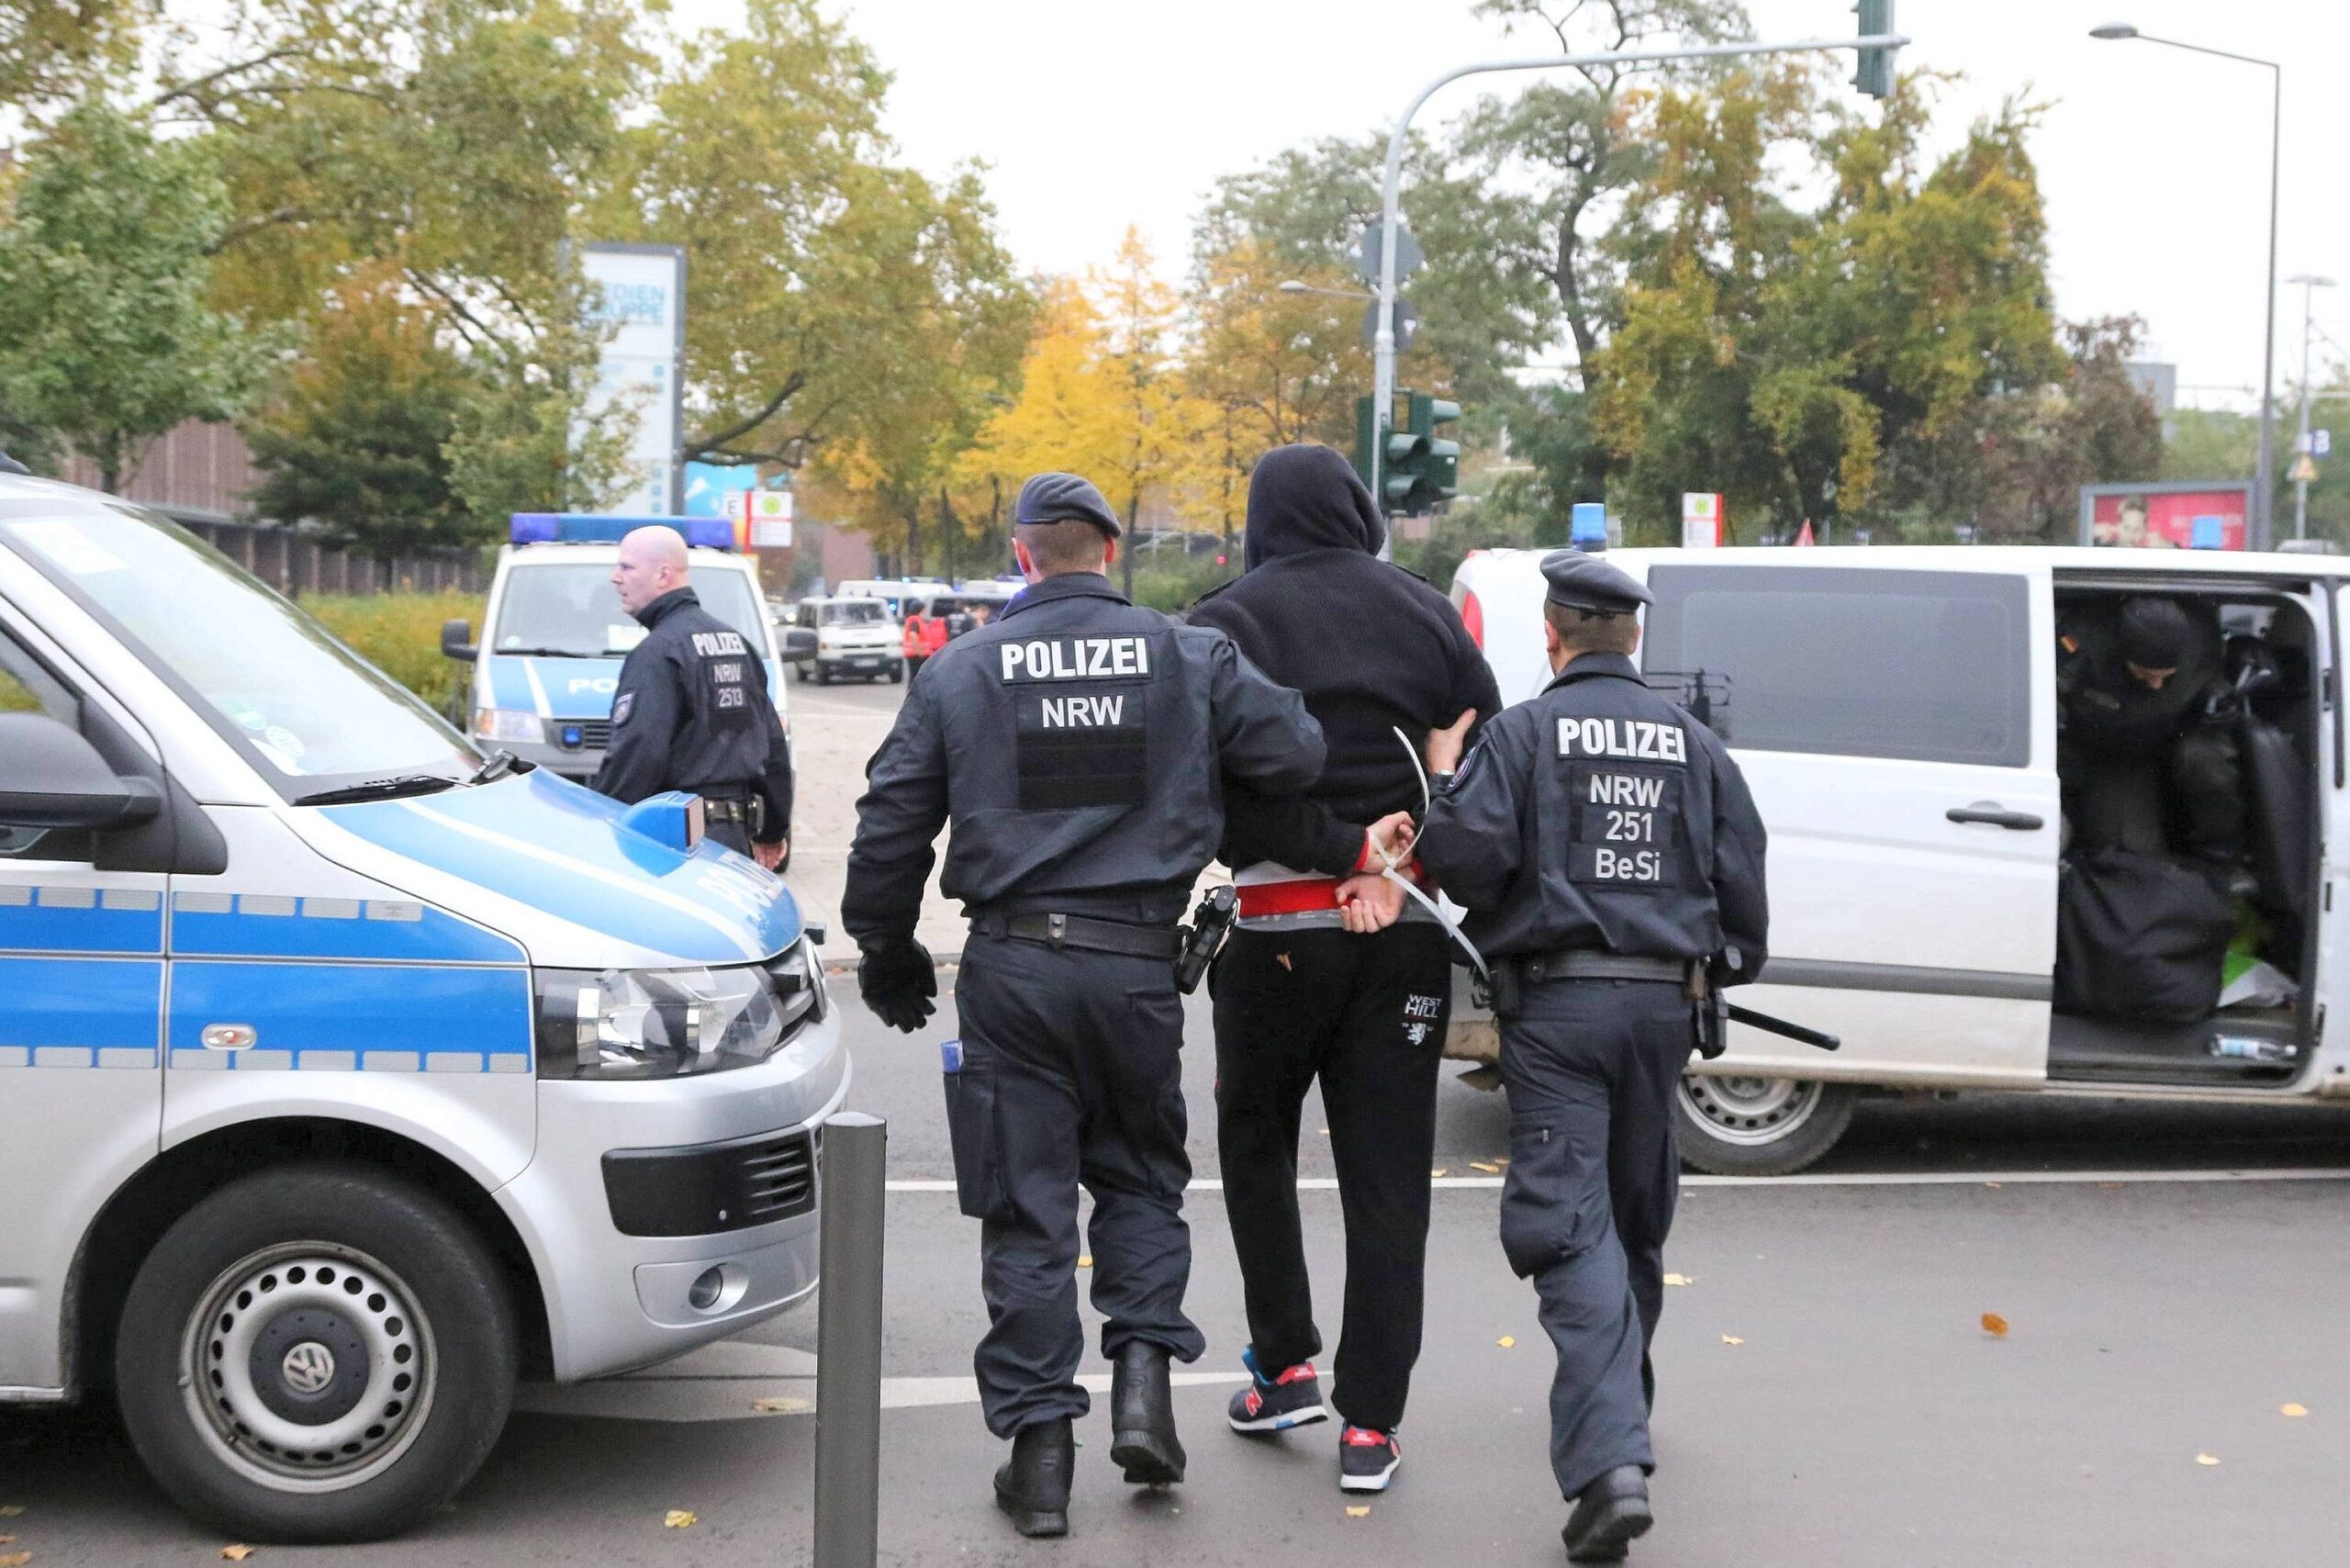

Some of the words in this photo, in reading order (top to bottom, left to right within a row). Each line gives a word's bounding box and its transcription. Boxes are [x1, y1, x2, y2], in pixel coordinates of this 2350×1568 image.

[691, 632, 747, 656] POLIZEI
[1001, 637, 1148, 680] POLIZEI
[714, 663, 742, 683] NRW
[1041, 695, 1124, 728] NRW
[1558, 718, 1687, 763] POLIZEI
[1590, 774, 1664, 808] NRW
[1606, 810, 1652, 842] 251
[1595, 847, 1661, 881] BeSi
[1404, 1002, 1438, 1018] HILL
[1409, 993, 1443, 1010] WEST
